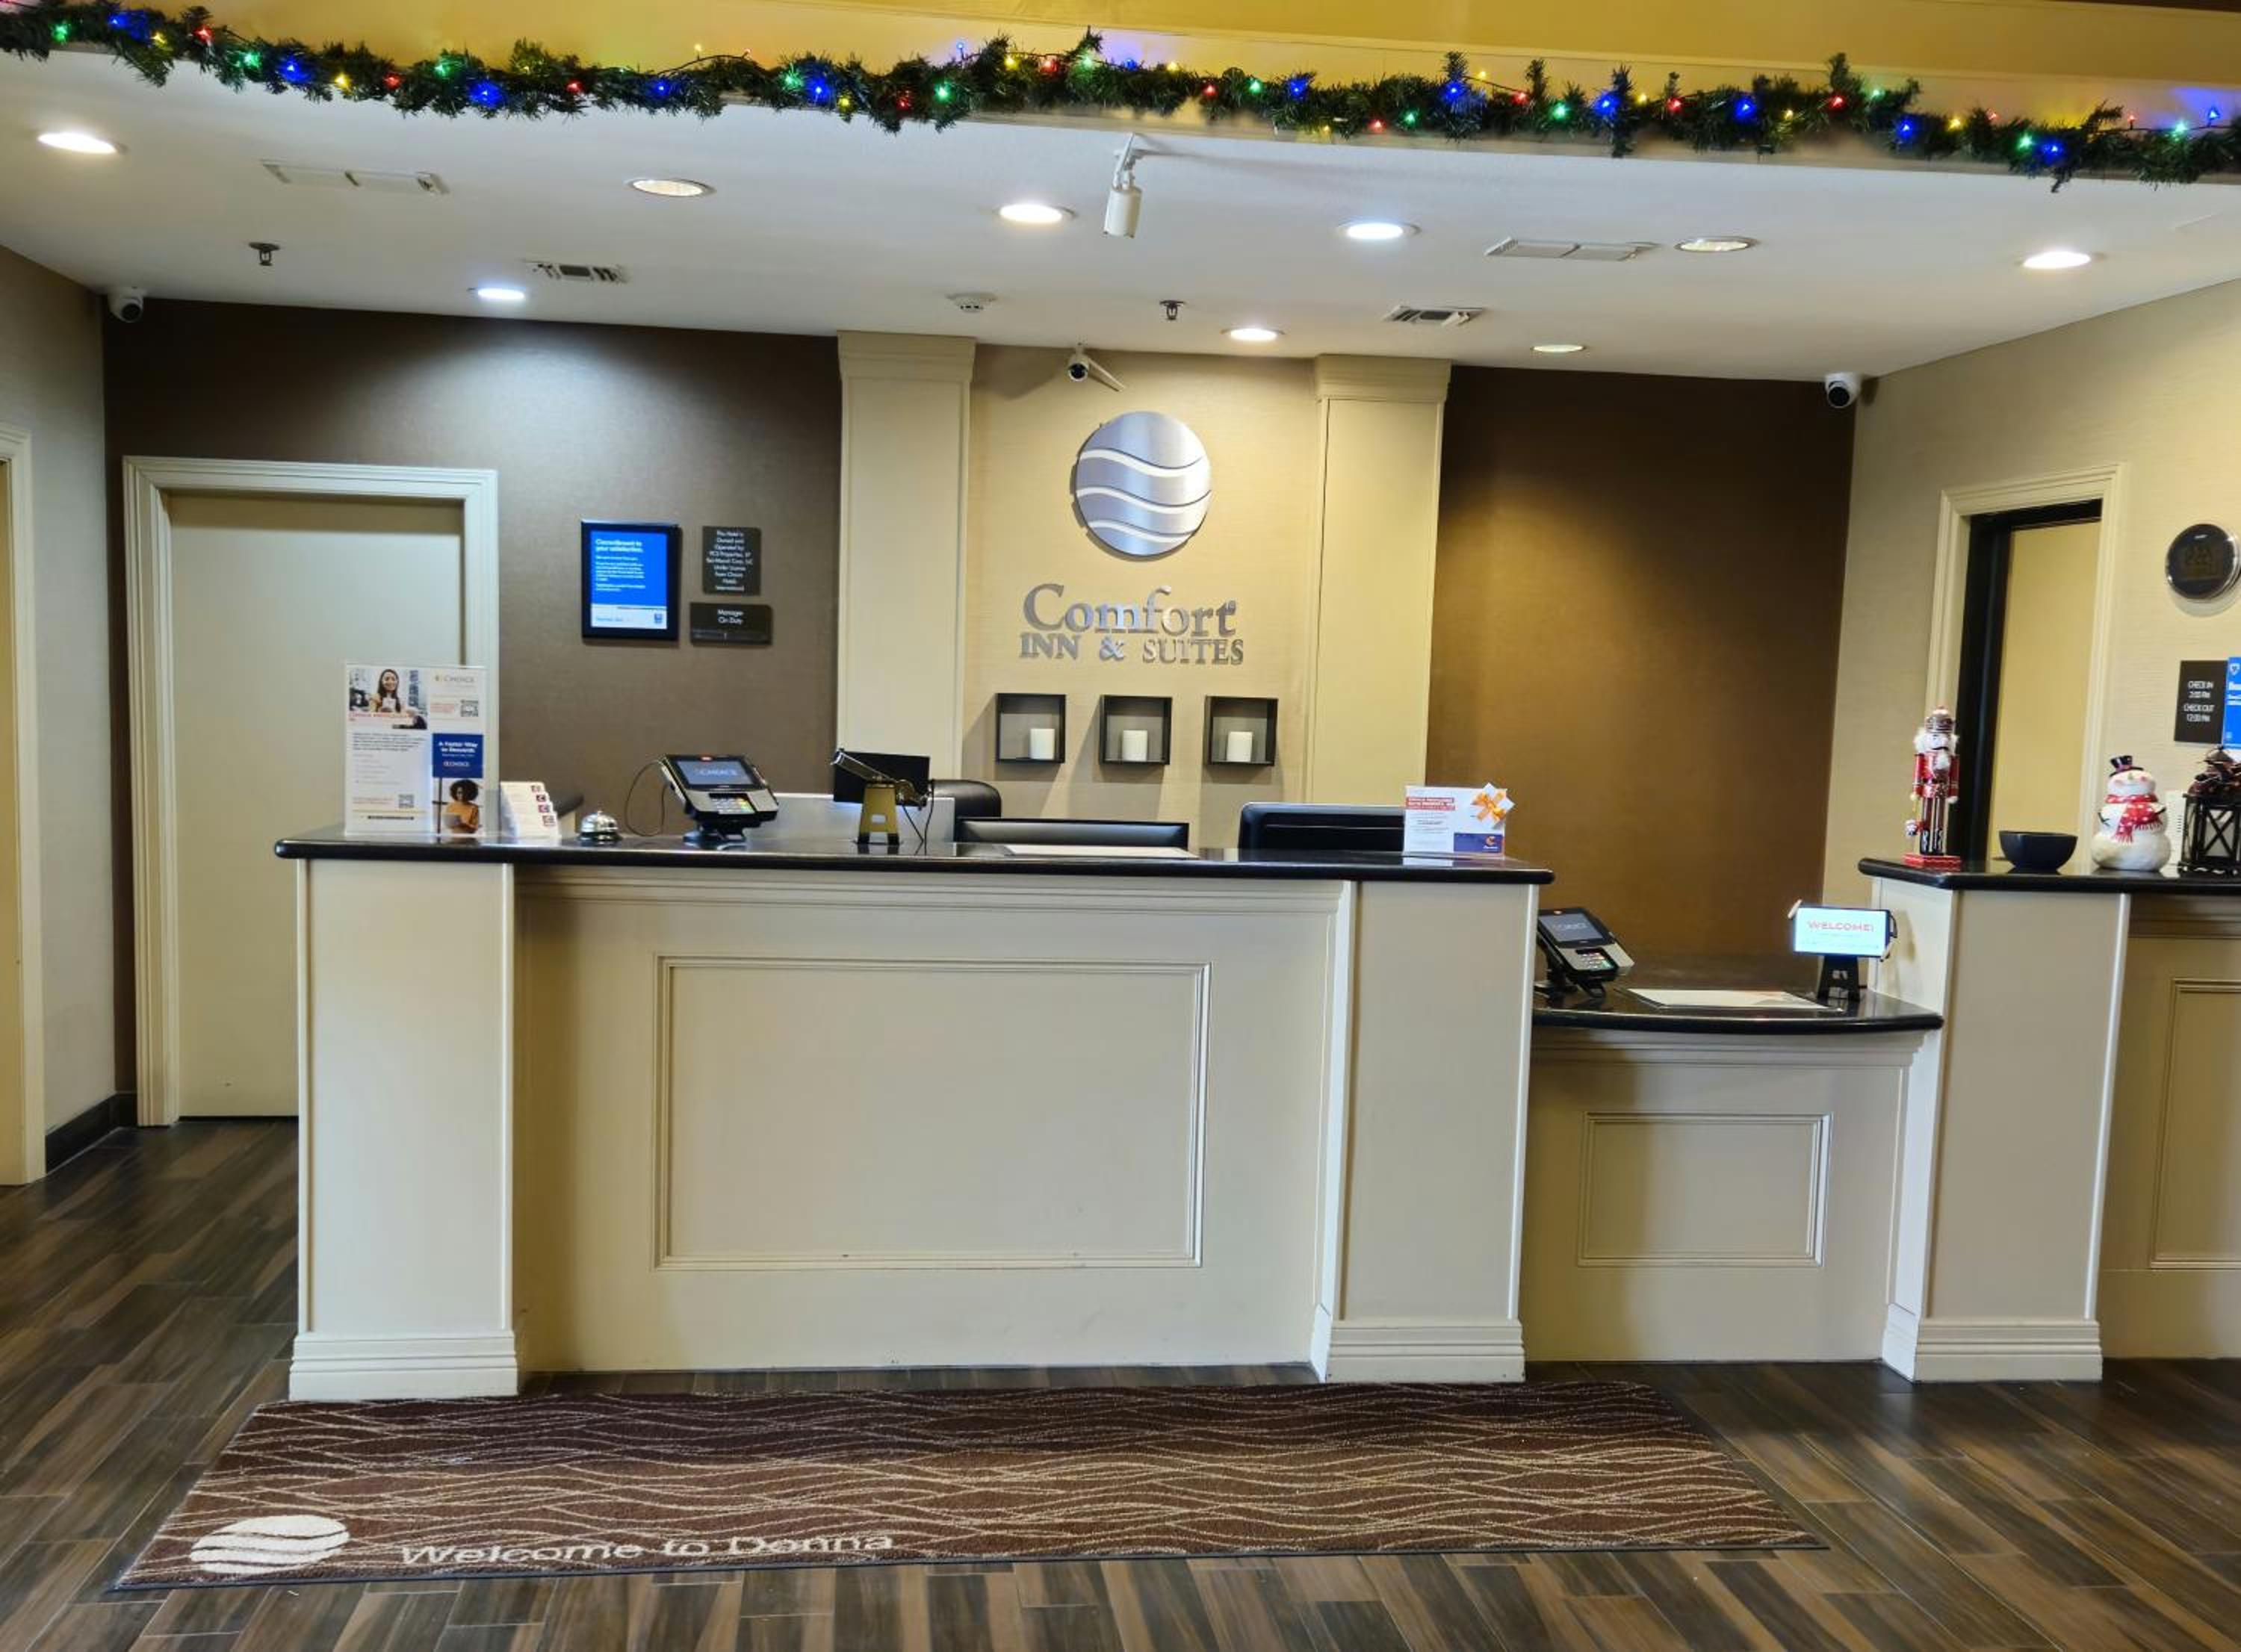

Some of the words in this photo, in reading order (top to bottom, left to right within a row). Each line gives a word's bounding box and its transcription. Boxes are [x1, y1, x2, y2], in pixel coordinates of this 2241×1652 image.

[717, 609, 743, 617] Manager
[1023, 583, 1236, 637] Comfort
[729, 617, 743, 625] Duty
[1019, 633, 1081, 660] INN
[1099, 636, 1126, 662] &
[1142, 638, 1243, 665] SUITES
[2188, 680, 2206, 689] CHECK
[2206, 681, 2214, 689] IN
[2183, 703, 2201, 712] CHECK
[2201, 704, 2215, 712] OUT
[1808, 920, 1873, 932] WELCOME!
[401, 1544, 644, 1565] Welcome
[663, 1540, 710, 1556] to
[729, 1535, 894, 1555] Donna
